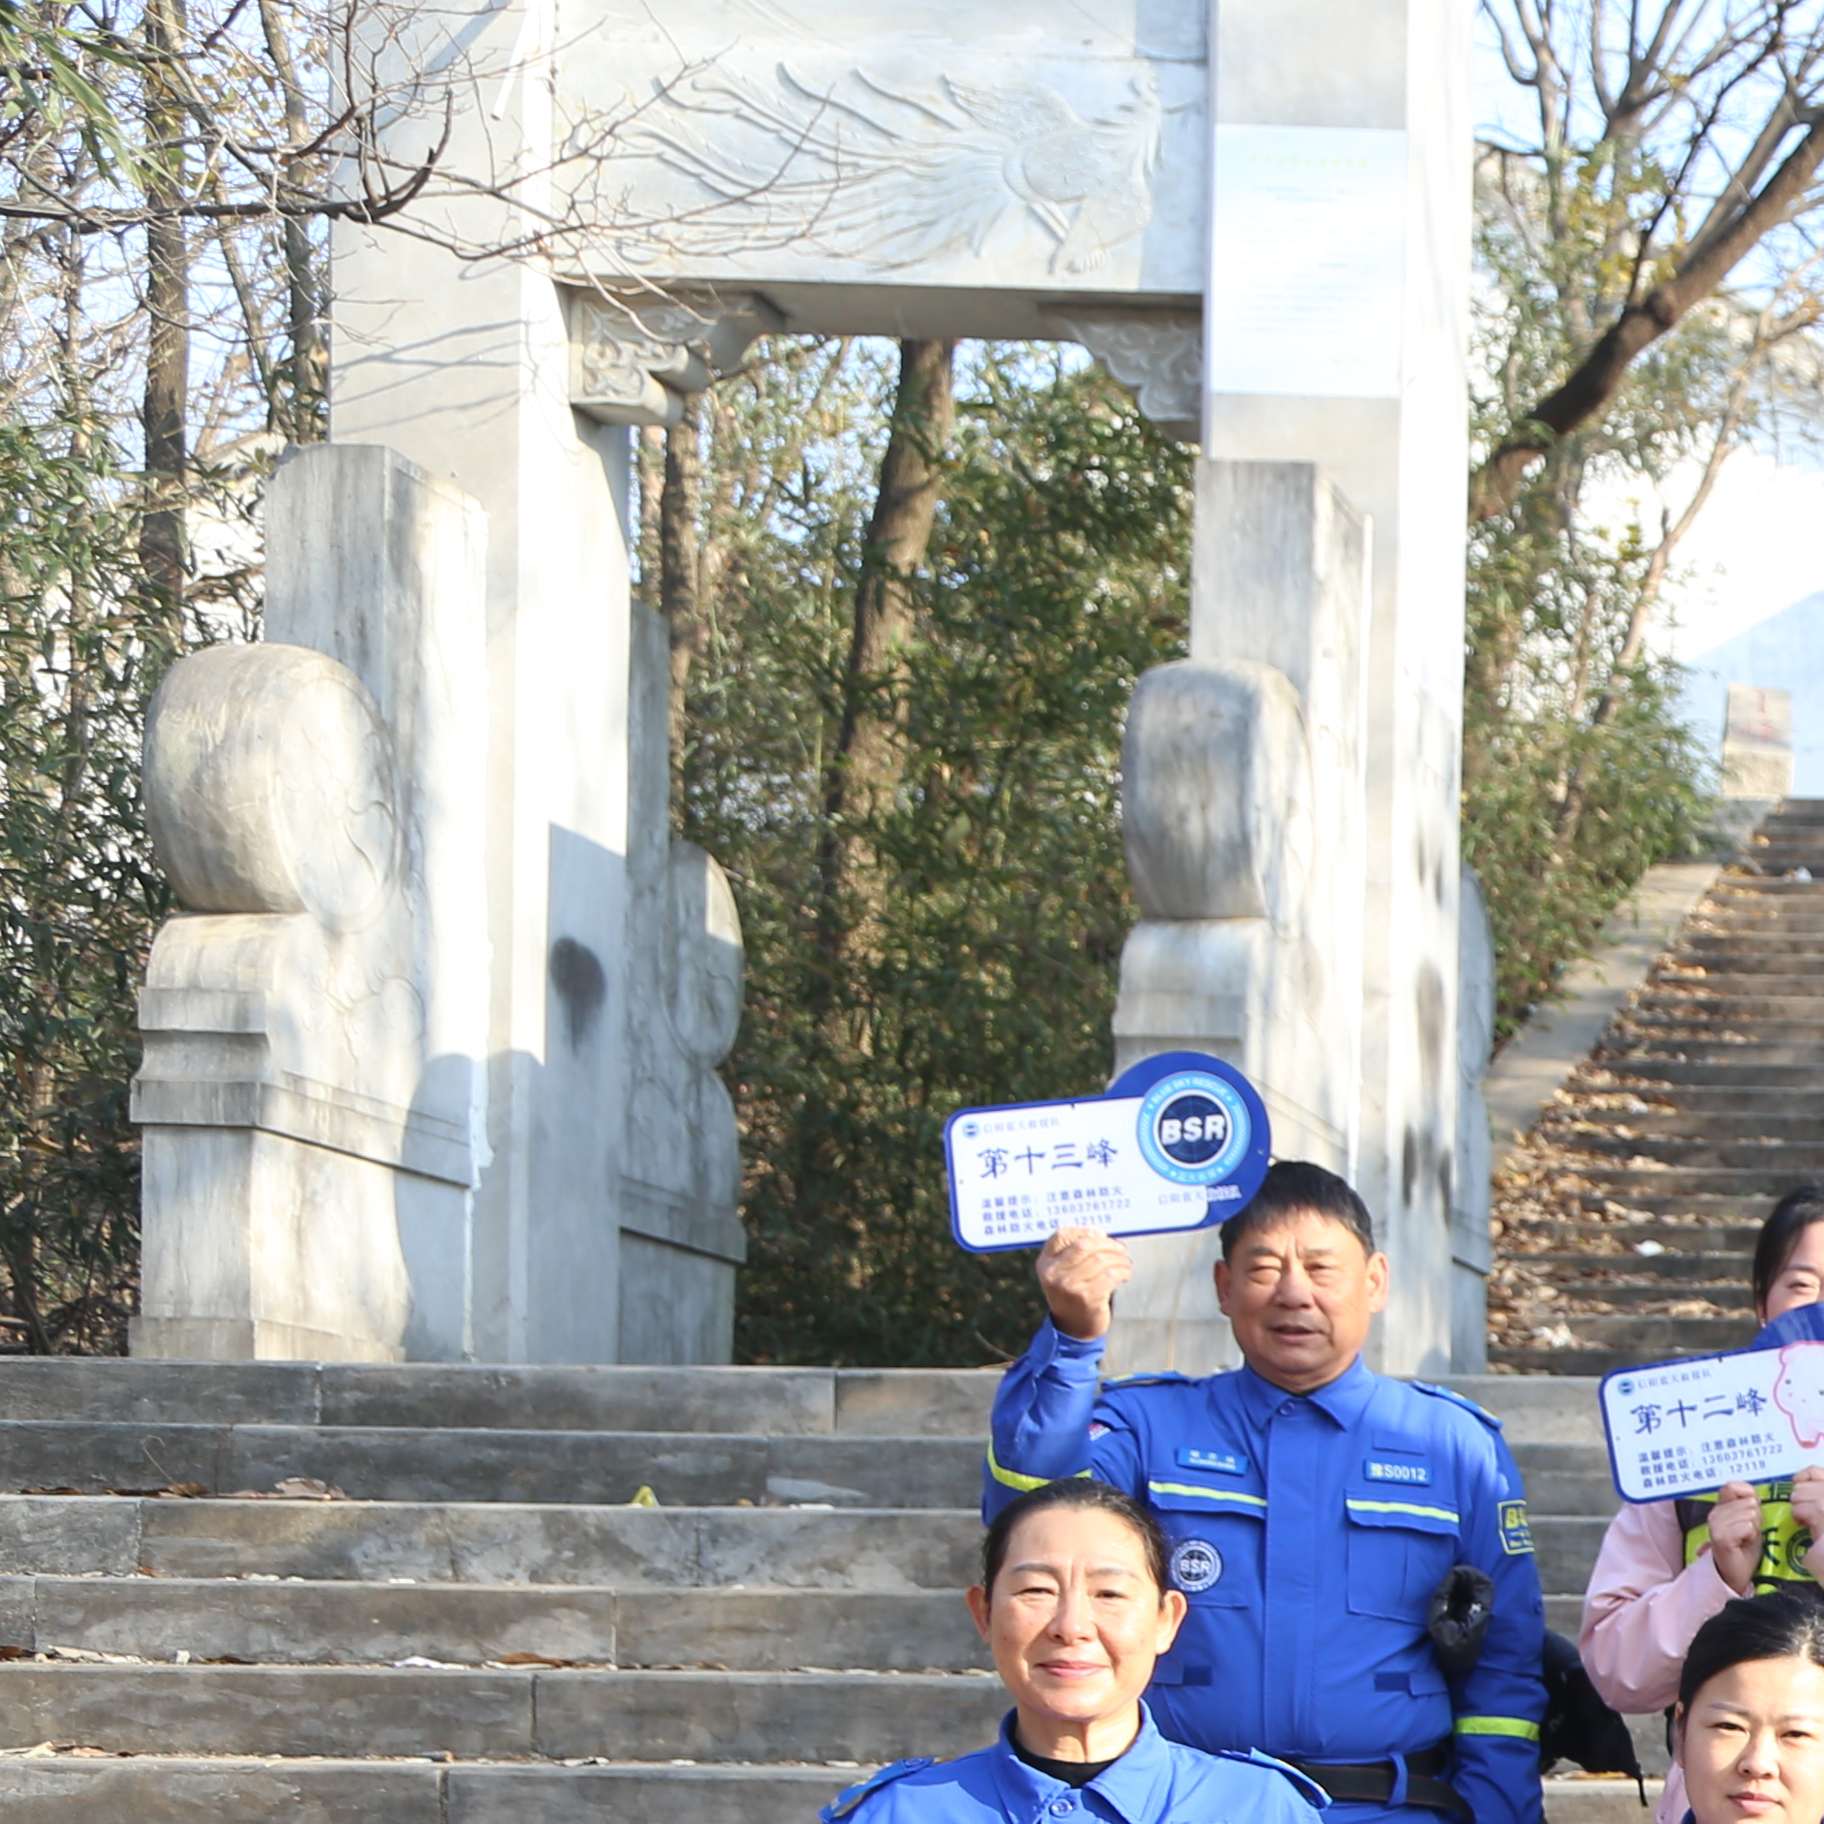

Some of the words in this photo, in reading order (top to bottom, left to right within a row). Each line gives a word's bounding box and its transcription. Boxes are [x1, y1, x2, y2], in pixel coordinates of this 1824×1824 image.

[1161, 1113, 1226, 1146] BSR
[977, 1139, 1118, 1179] 第十三峰
[1630, 1387, 1767, 1435] 第十二峰
[1180, 1558, 1211, 1574] BSR
